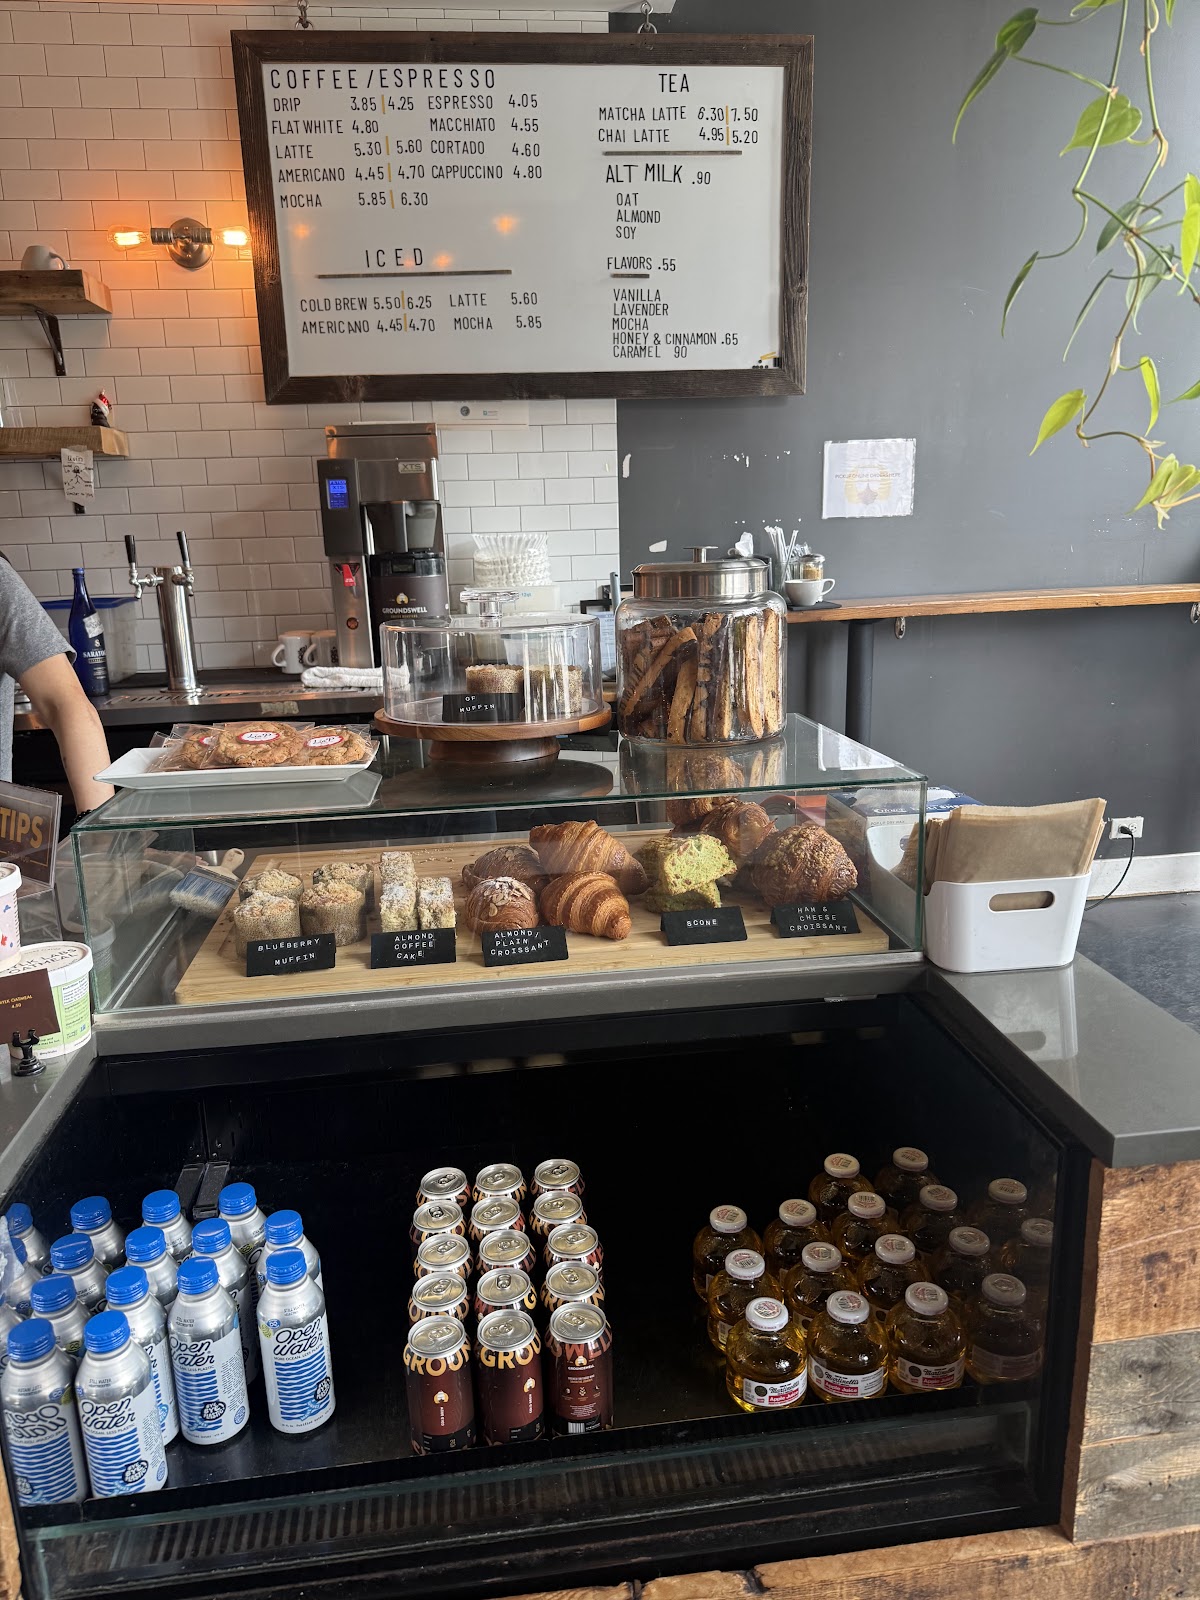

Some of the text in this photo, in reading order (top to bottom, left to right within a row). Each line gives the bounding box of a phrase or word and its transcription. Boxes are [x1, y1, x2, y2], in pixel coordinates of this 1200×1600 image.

[271, 69, 495, 89] COFFEE/ESPRESSO
[659, 73, 690, 93] TEA
[273, 96, 414, 112] DRIP 3.85 4.25
[428, 93, 538, 110] ESPRESSO 4.05
[599, 105, 758, 122] MATCHA LATTE 6.30 7.50
[272, 120, 379, 134] FLAT WHITE 4.80
[430, 117, 539, 132] MACCHIATO 4.55
[598, 126, 758, 144] CHAI LATTE 4.95 5.20
[275, 139, 423, 159] LATTE 5.30 5.60
[431, 140, 539, 158] CORTADO 4.60
[278, 165, 425, 183] AMERICANO 4.45 4.70
[432, 165, 542, 180] CAPPUCCINO 4.80
[606, 164, 711, 185] ALT MILK .90
[280, 191, 428, 208] MOCHA 5.85 6.30
[616, 192, 639, 206] OAT
[616, 209, 661, 223] ALMOND
[616, 226, 637, 240] SOY
[365, 248, 424, 268] ICED
[608, 257, 676, 271] FLAVORS .55
[450, 292, 538, 307] LATTE 5.60
[613, 288, 661, 302] VANILLA
[300, 296, 432, 312] COLD BREW 5.50 6.25
[614, 303, 669, 316] LAVENDER
[302, 318, 436, 334] AMERICANO 4.45 4.70
[454, 316, 542, 330] MOCHA 5.85
[612, 318, 649, 330] MOCHA
[613, 332, 738, 345] HONEY & CINNAMON .65
[613, 345, 687, 358] CARAMEL 90
[382, 606, 427, 614] GROUNDSWELL
[0, 806, 43, 849] TIPS
[798, 906, 816, 914] HAM
[687, 919, 717, 927] SCONE
[790, 923, 847, 931] CROISSANT
[395, 932, 434, 942] ALMOND
[494, 930, 540, 939] ALMOND/
[258, 938, 320, 951] BLUEBERRY
[394, 941, 434, 949] COFFEE
[490, 939, 550, 956] CROISSANT
[496, 938, 529, 947] PLAIN
[274, 952, 315, 966] MUFFIN
[396, 950, 424, 960] CAKE
[276, 1319, 321, 1344] Open
[273, 1332, 323, 1356] water
[81, 1398, 131, 1418] Open
[82, 1410, 135, 1431] water
